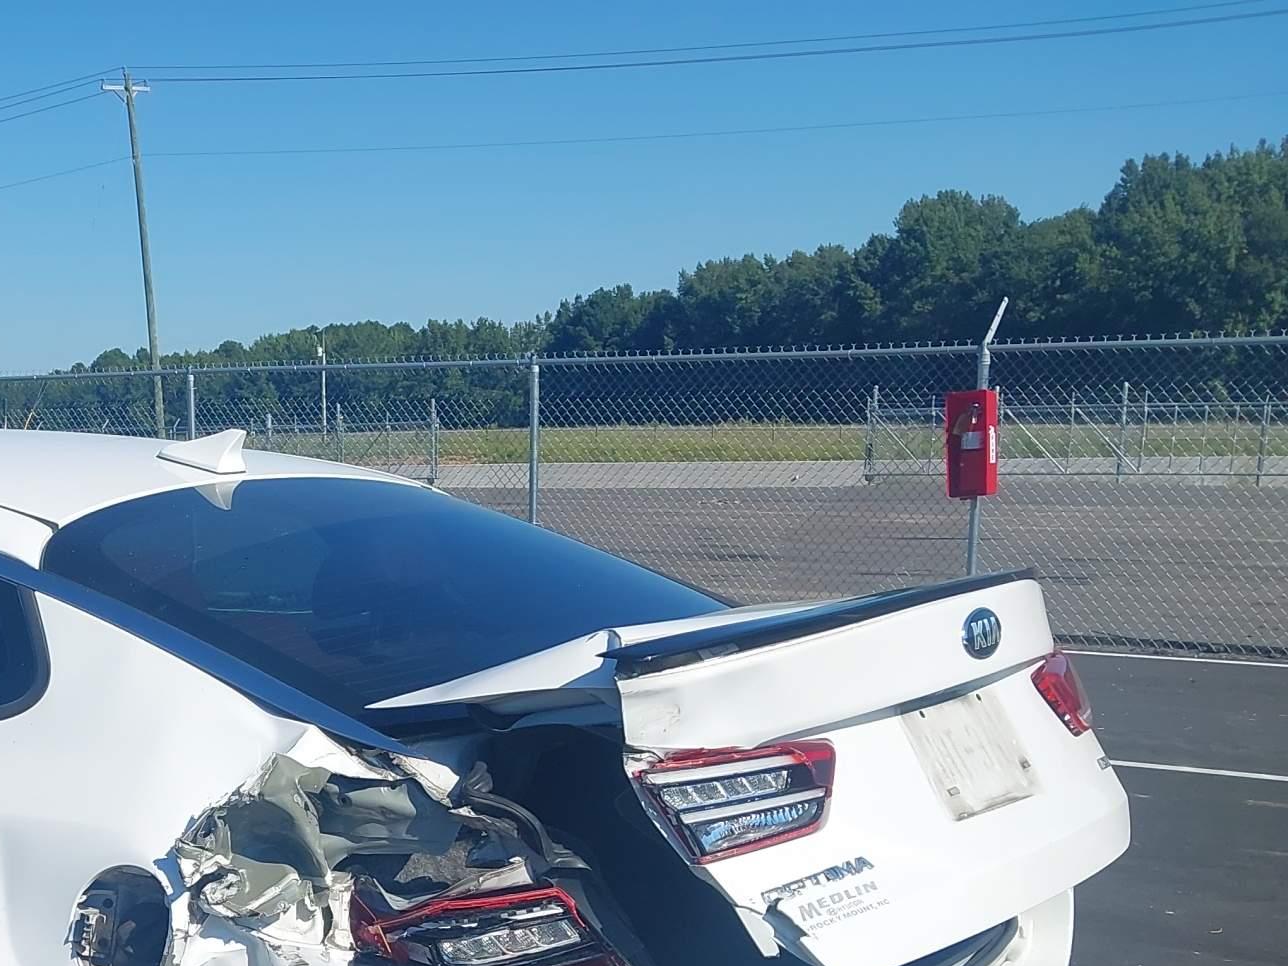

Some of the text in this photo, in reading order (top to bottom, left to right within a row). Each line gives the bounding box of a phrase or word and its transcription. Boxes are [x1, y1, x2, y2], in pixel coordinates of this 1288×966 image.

[970, 616, 1000, 650] KIA
[798, 880, 879, 922] MEDLIN
[809, 915, 842, 931] ROCKY
